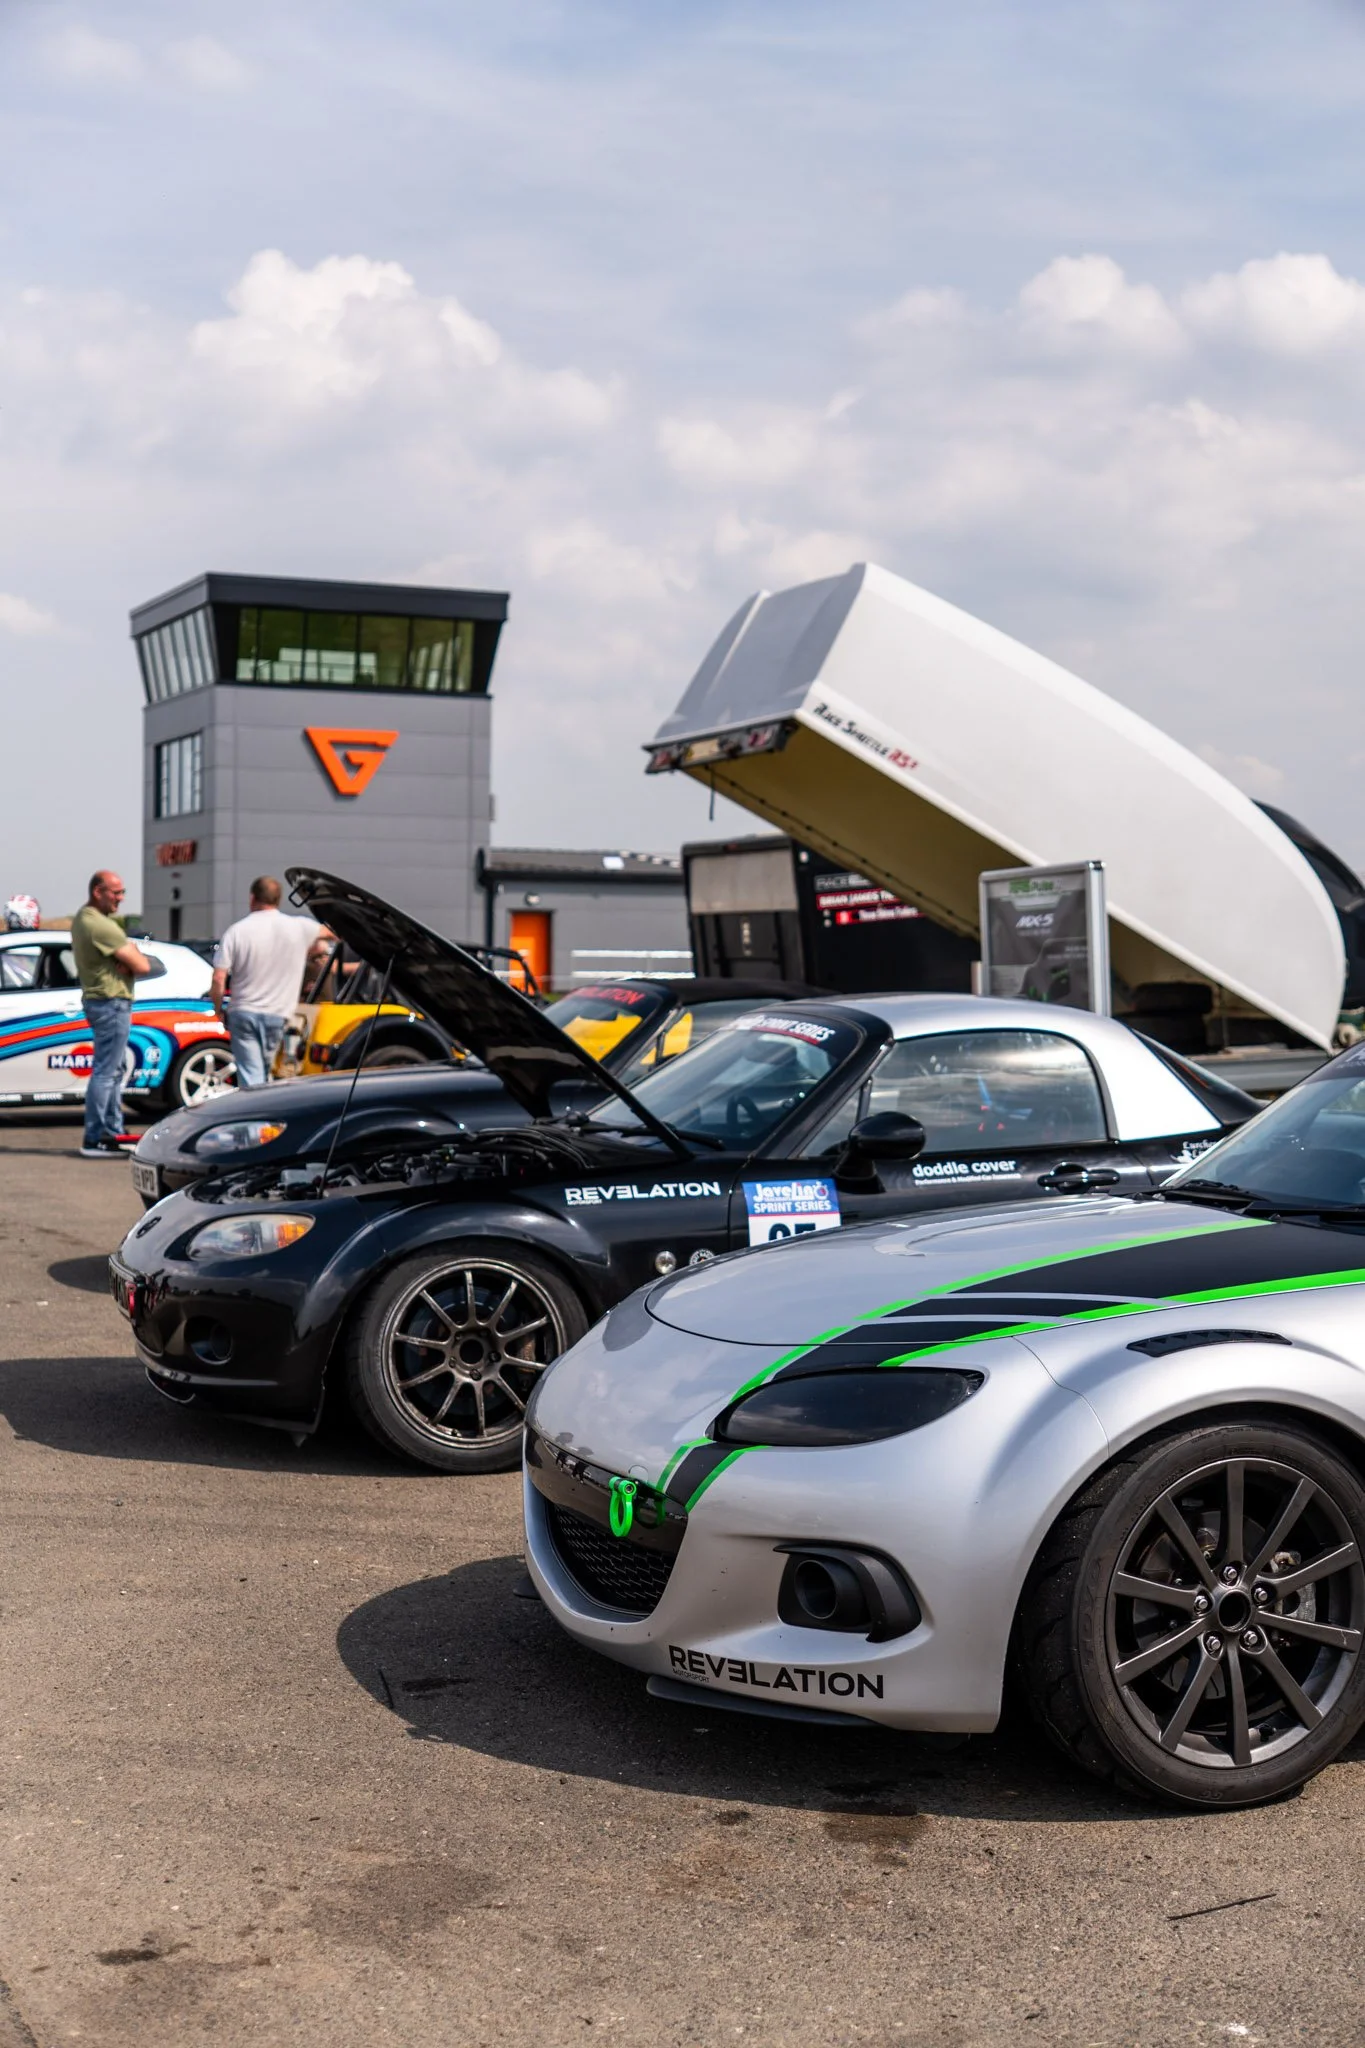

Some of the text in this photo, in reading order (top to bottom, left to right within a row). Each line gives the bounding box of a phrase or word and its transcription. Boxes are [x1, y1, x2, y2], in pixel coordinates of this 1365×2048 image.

[51, 1055, 94, 1069] MART
[912, 1160, 1016, 1178] doddle cover
[754, 1199, 832, 1213] SPRINT SERIES
[672, 1667, 710, 1684] MOTORSPORT
